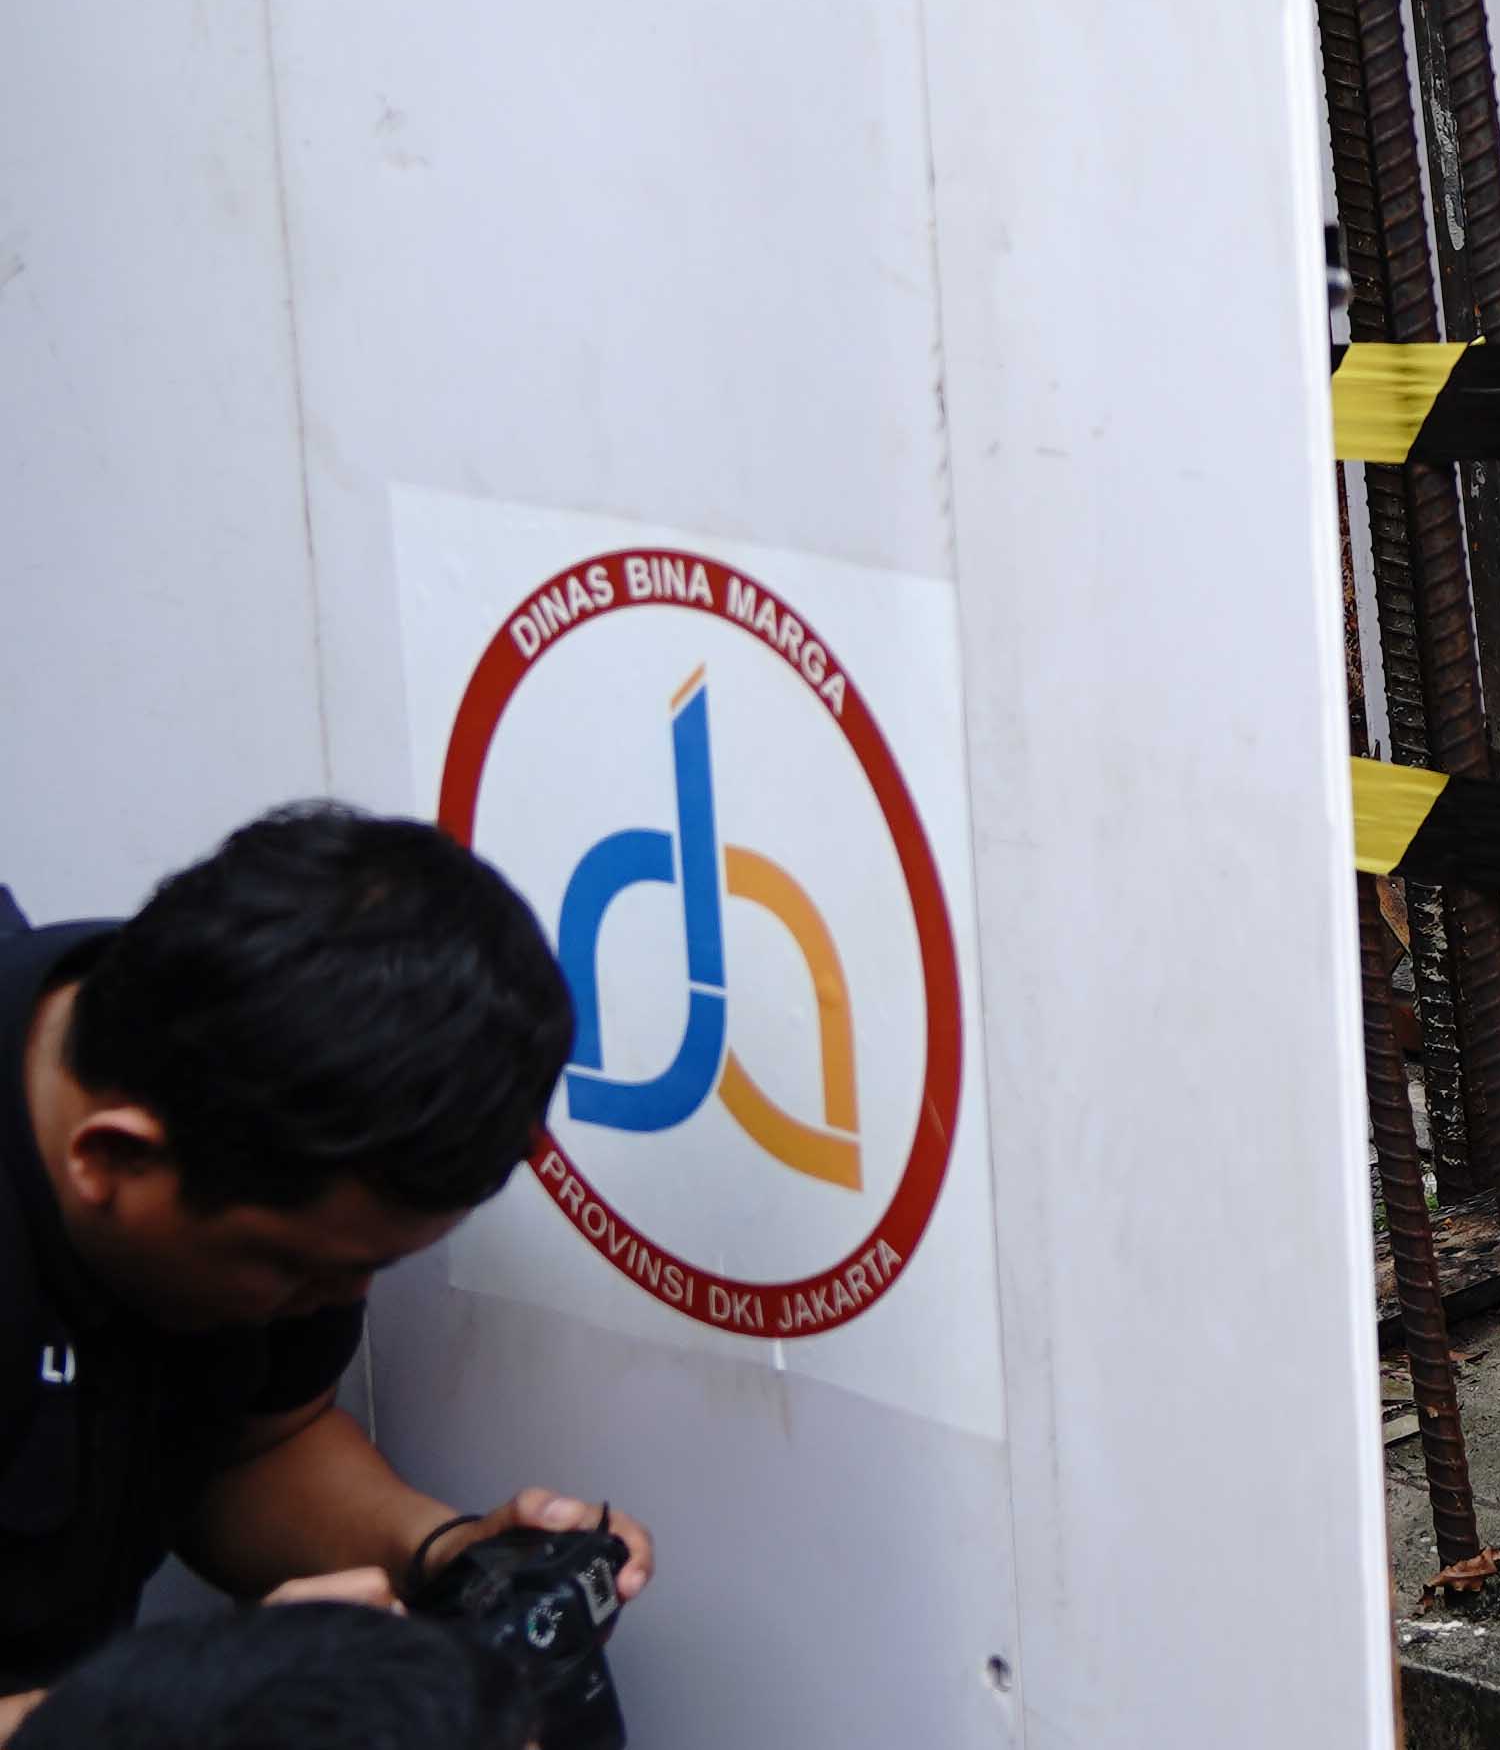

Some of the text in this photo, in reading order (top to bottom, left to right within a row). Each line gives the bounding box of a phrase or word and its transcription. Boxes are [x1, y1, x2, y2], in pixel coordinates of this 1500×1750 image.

[511, 556, 847, 717] DINAS BINA MARGA
[540, 1150, 903, 1332] PROVINSI DKI JAKARTA
